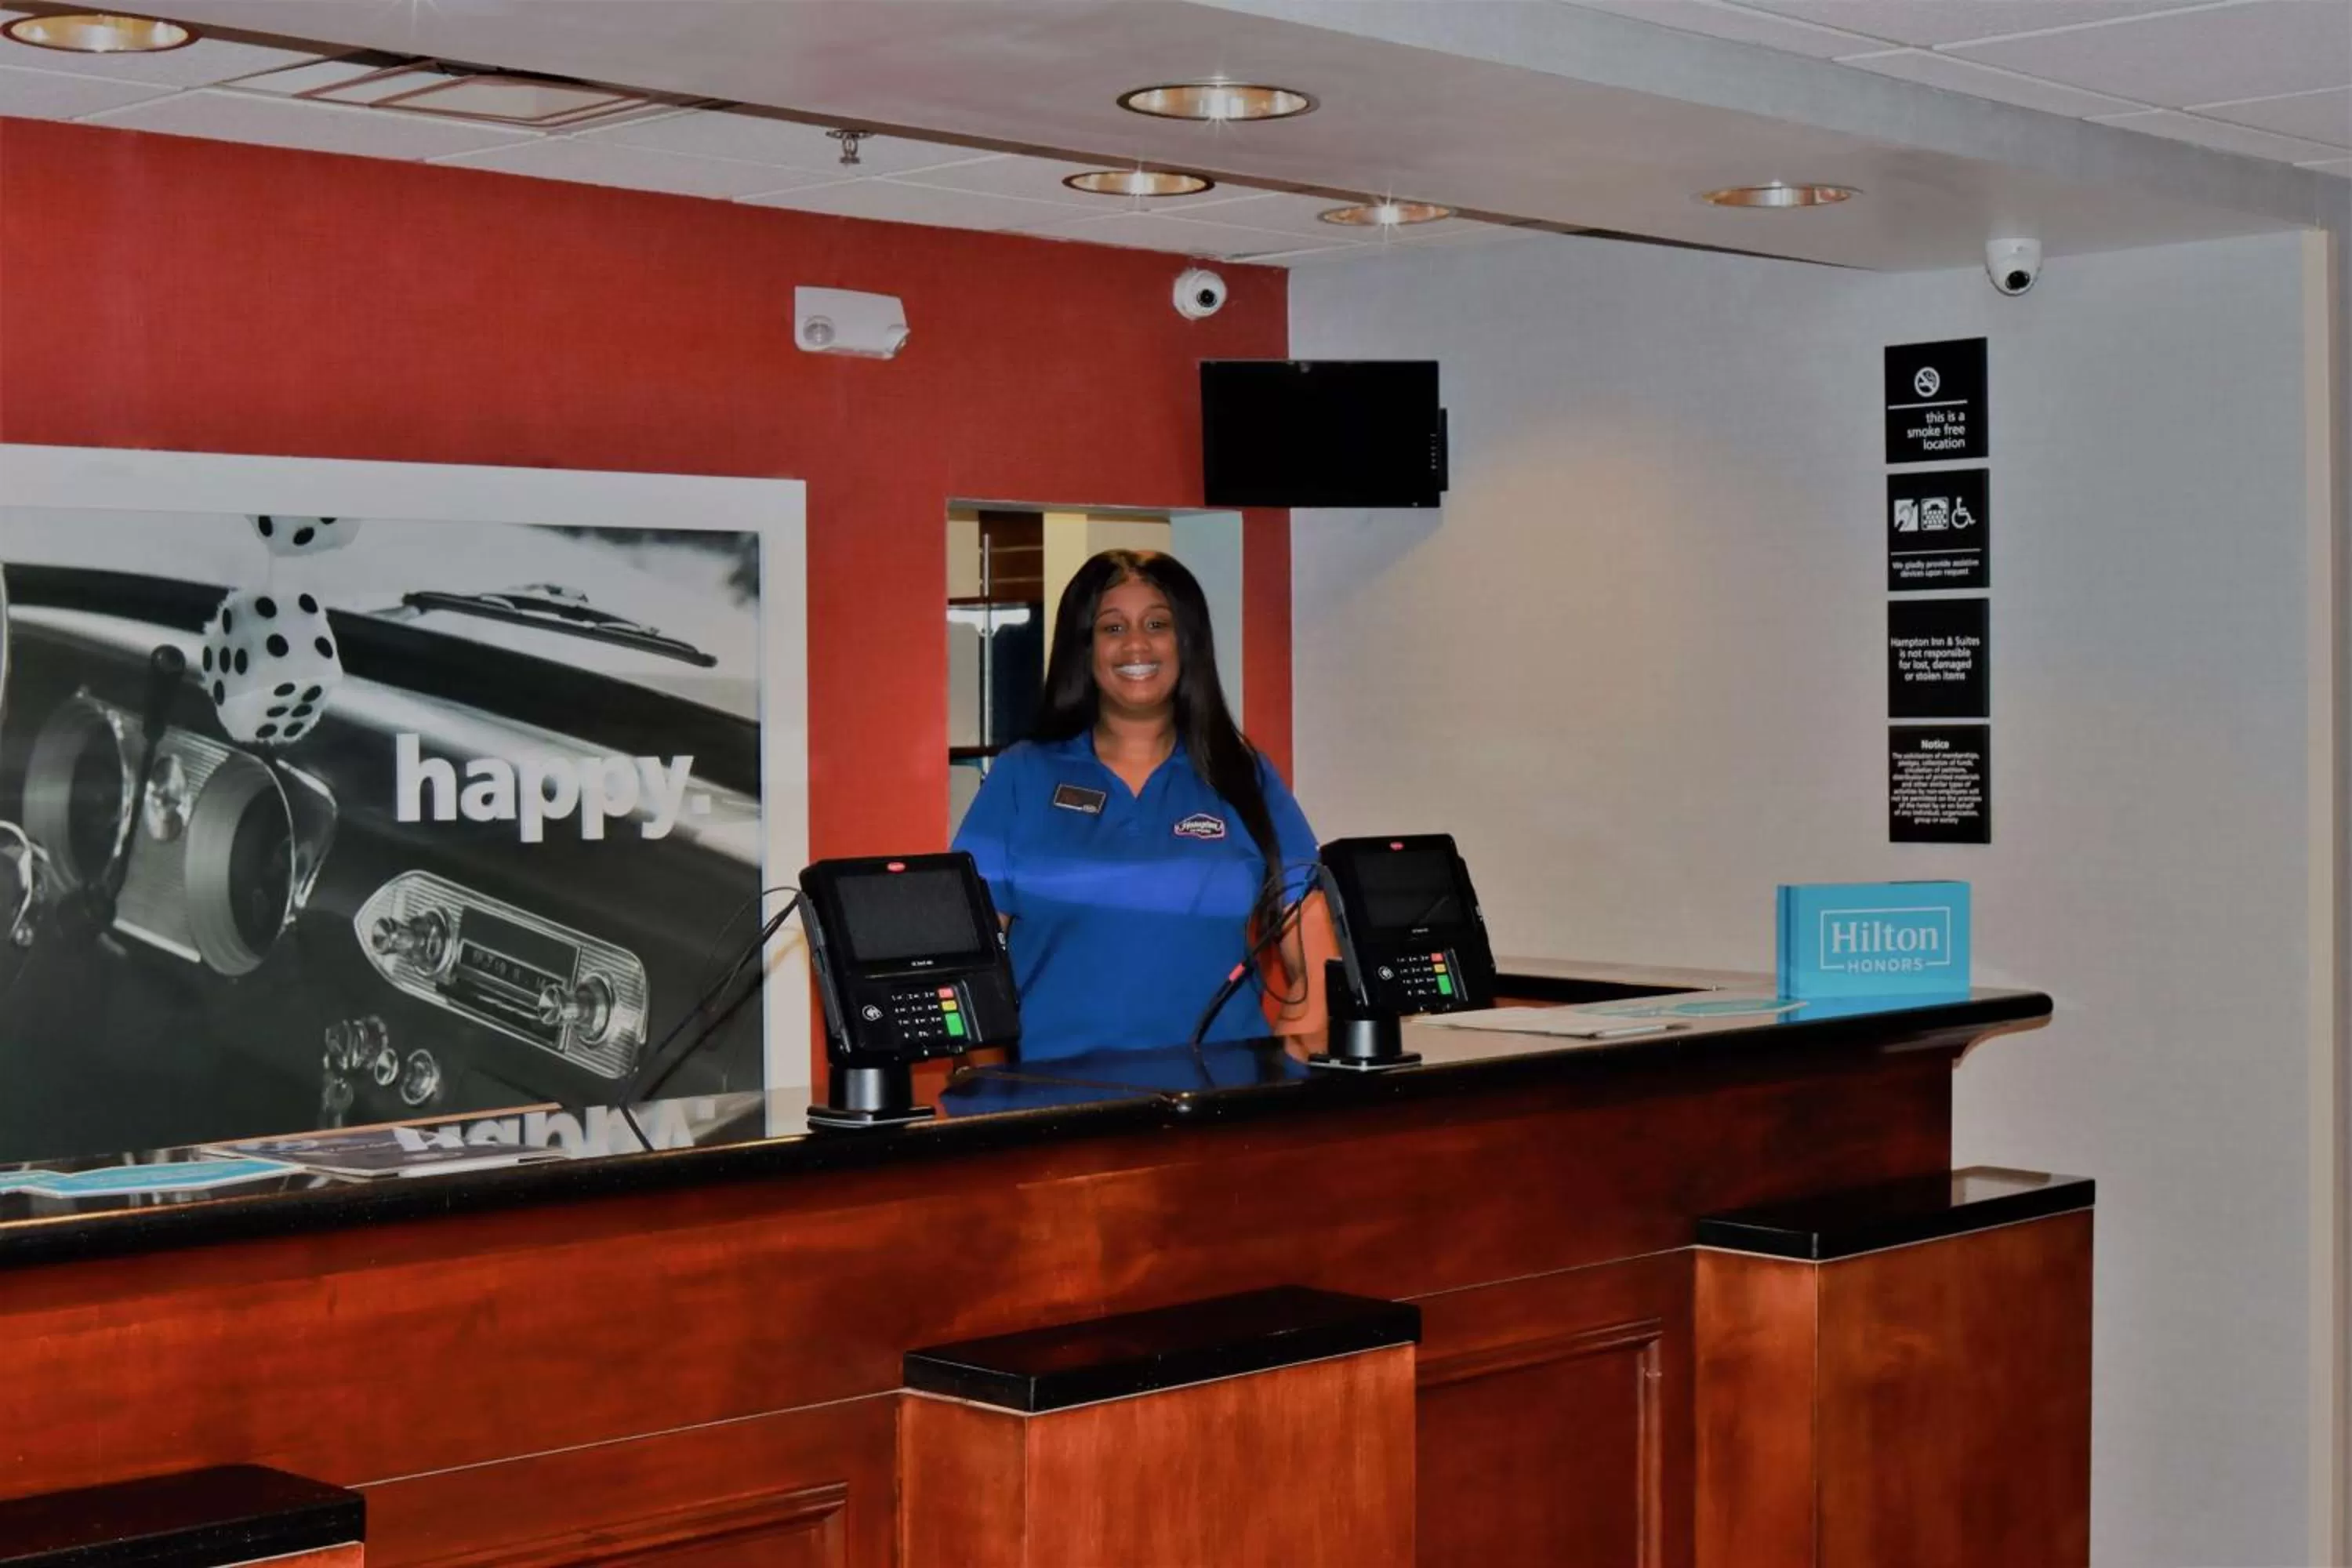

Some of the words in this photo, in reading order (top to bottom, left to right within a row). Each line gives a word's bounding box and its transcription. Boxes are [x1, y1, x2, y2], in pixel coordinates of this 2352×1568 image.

[1926, 411, 1944, 423] this
[1947, 410, 1955, 422] is
[1958, 412, 1965, 421] a
[1907, 424, 1940, 438] smoke
[1944, 423, 1965, 435] free
[1923, 437, 1965, 450] location
[1891, 637, 1929, 648] Hampton
[1932, 637, 1944, 646] Inn
[1947, 637, 1953, 646] &
[1955, 636, 1980, 646] Suites
[1900, 649, 1905, 658] is
[1907, 649, 1922, 658] not
[1924, 648, 1971, 659] responsible
[1899, 660, 1911, 670] for
[1913, 660, 1929, 670] lost,
[1932, 659, 1972, 670] damaged
[1916, 671, 1941, 681] stolen
[1943, 670, 1965, 680] items
[1921, 740, 1950, 749] Notice
[397, 733, 711, 843] happy.
[1831, 920, 1939, 953] Hilton
[1847, 957, 1923, 973] HONORS
